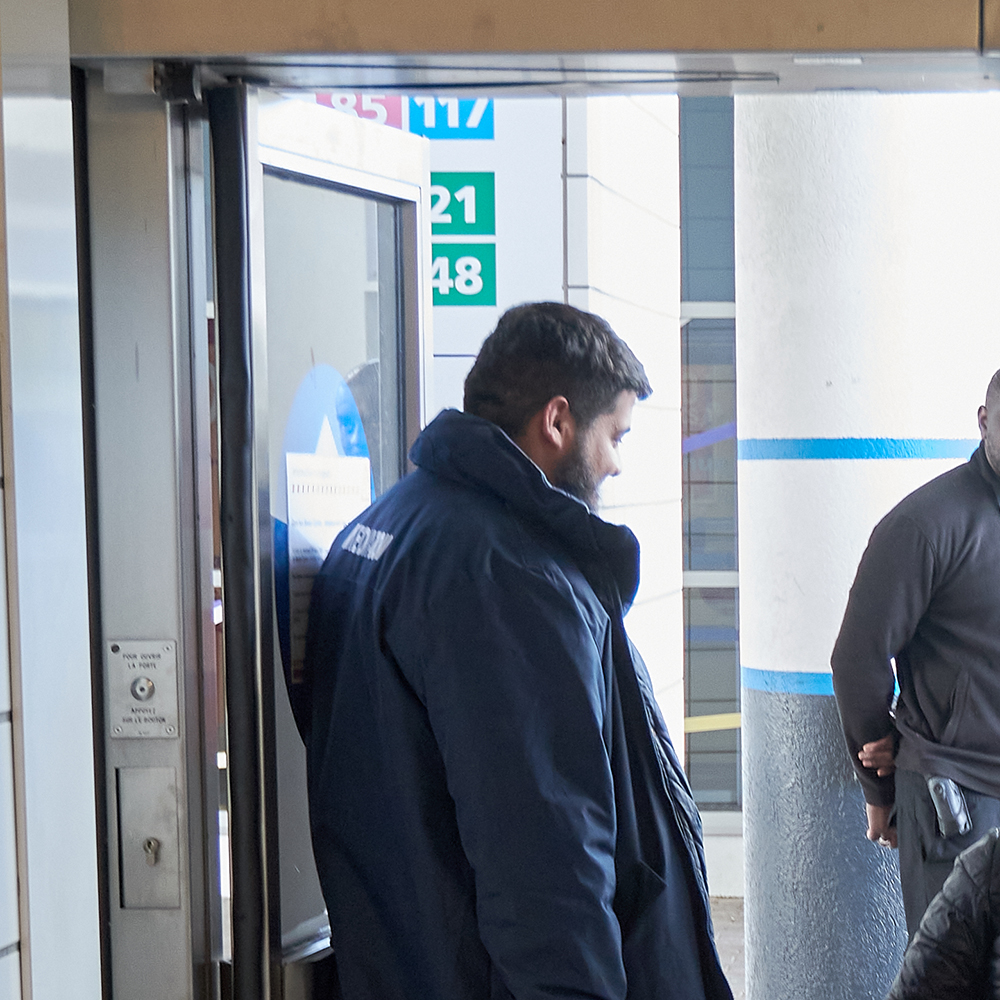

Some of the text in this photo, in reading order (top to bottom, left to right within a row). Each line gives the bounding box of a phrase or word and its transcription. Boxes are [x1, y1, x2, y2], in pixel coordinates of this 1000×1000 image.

[331, 92, 490, 128] 85 117
[430, 185, 476, 224] 21
[431, 256, 484, 295] 48
